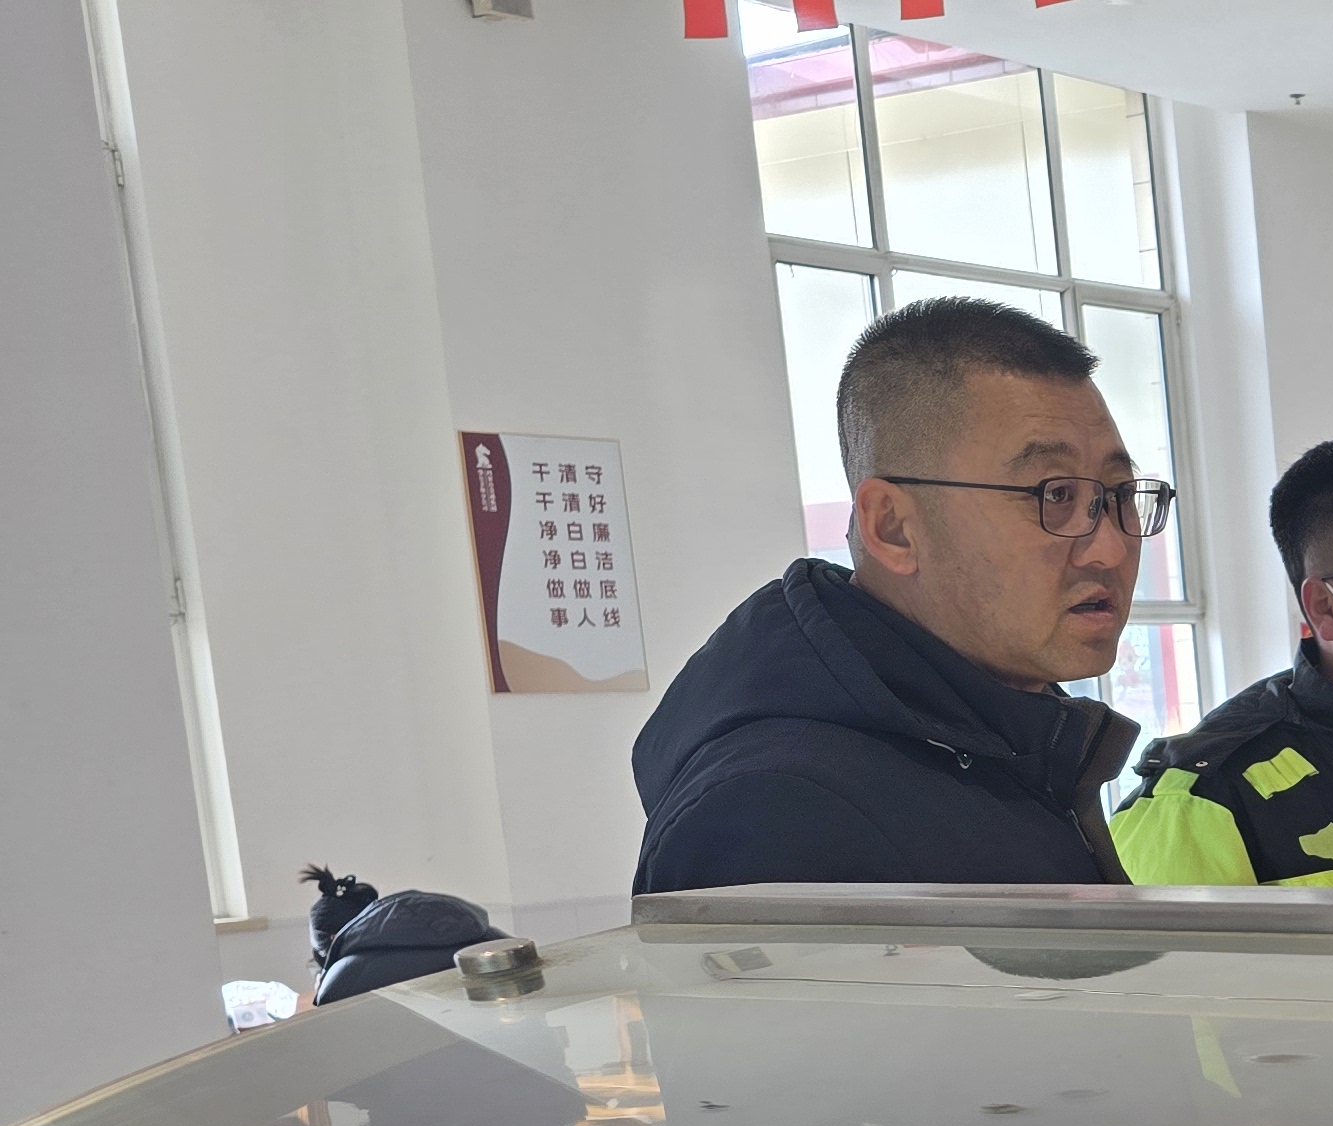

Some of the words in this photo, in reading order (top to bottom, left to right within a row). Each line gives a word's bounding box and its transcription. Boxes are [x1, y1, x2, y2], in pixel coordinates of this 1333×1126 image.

[532, 462, 569, 628] 干干净净做事
[558, 463, 597, 628] 清清白白做人
[585, 464, 621, 628] 守好廉洁底线
